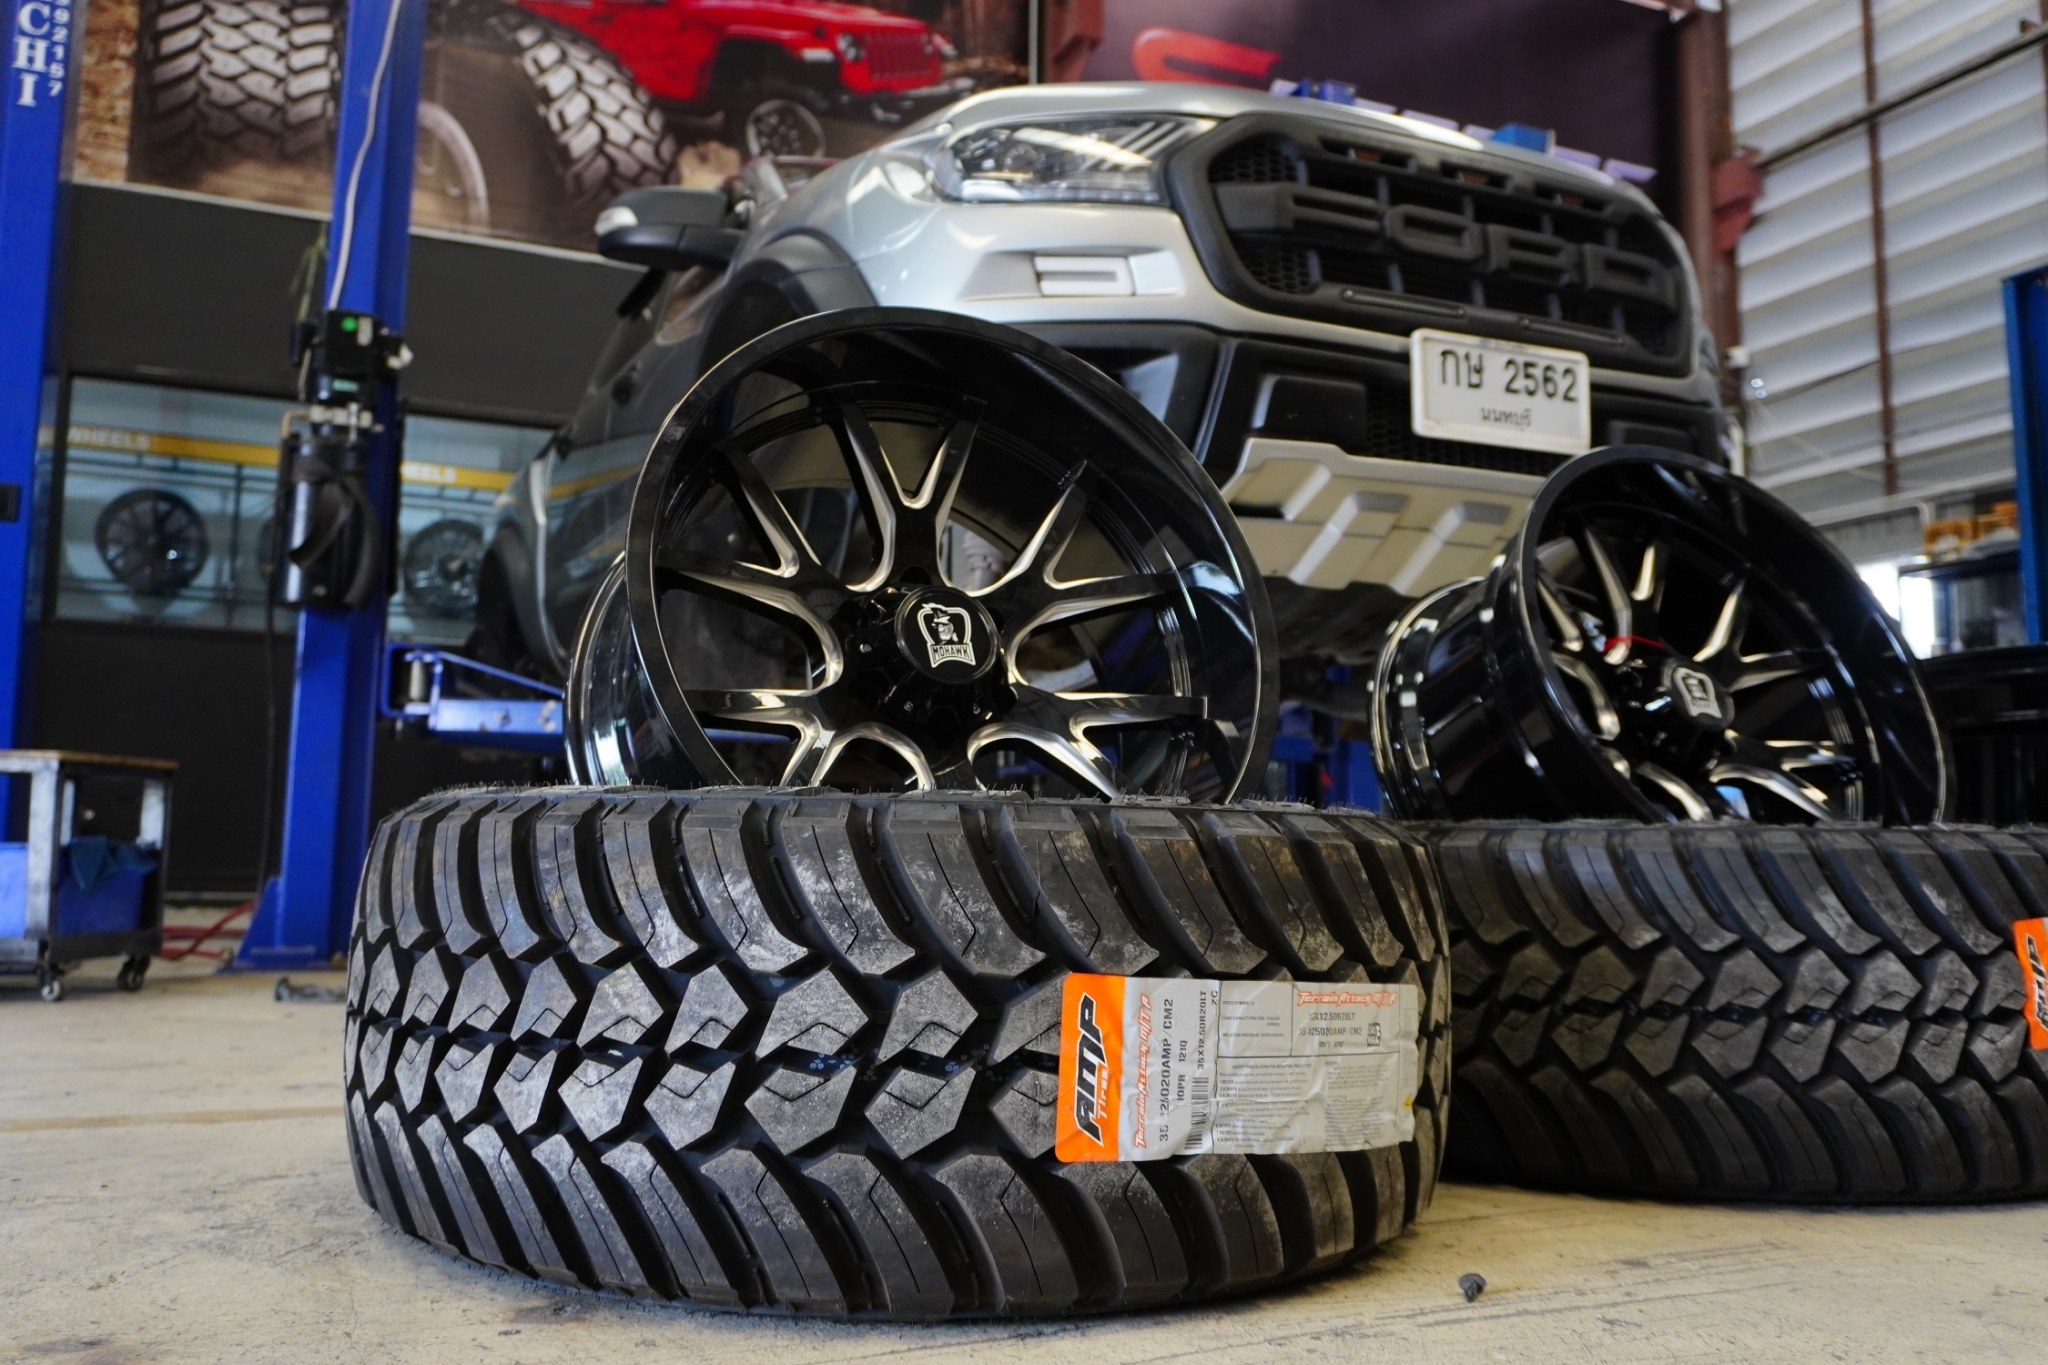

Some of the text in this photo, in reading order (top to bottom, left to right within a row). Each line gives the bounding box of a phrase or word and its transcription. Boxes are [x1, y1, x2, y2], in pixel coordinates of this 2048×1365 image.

[12, 0, 51, 107] CHI
[1272, 184, 1676, 308] FORD
[1504, 358, 1578, 402] 2562
[932, 644, 970, 661] MOHAWK
[1196, 991, 1207, 1070] 35X12.50R20LT
[1074, 992, 1108, 1148] AMP
[1097, 1067, 1109, 1119] Tires
[1177, 1040, 1189, 1101] 10PR 121Q
